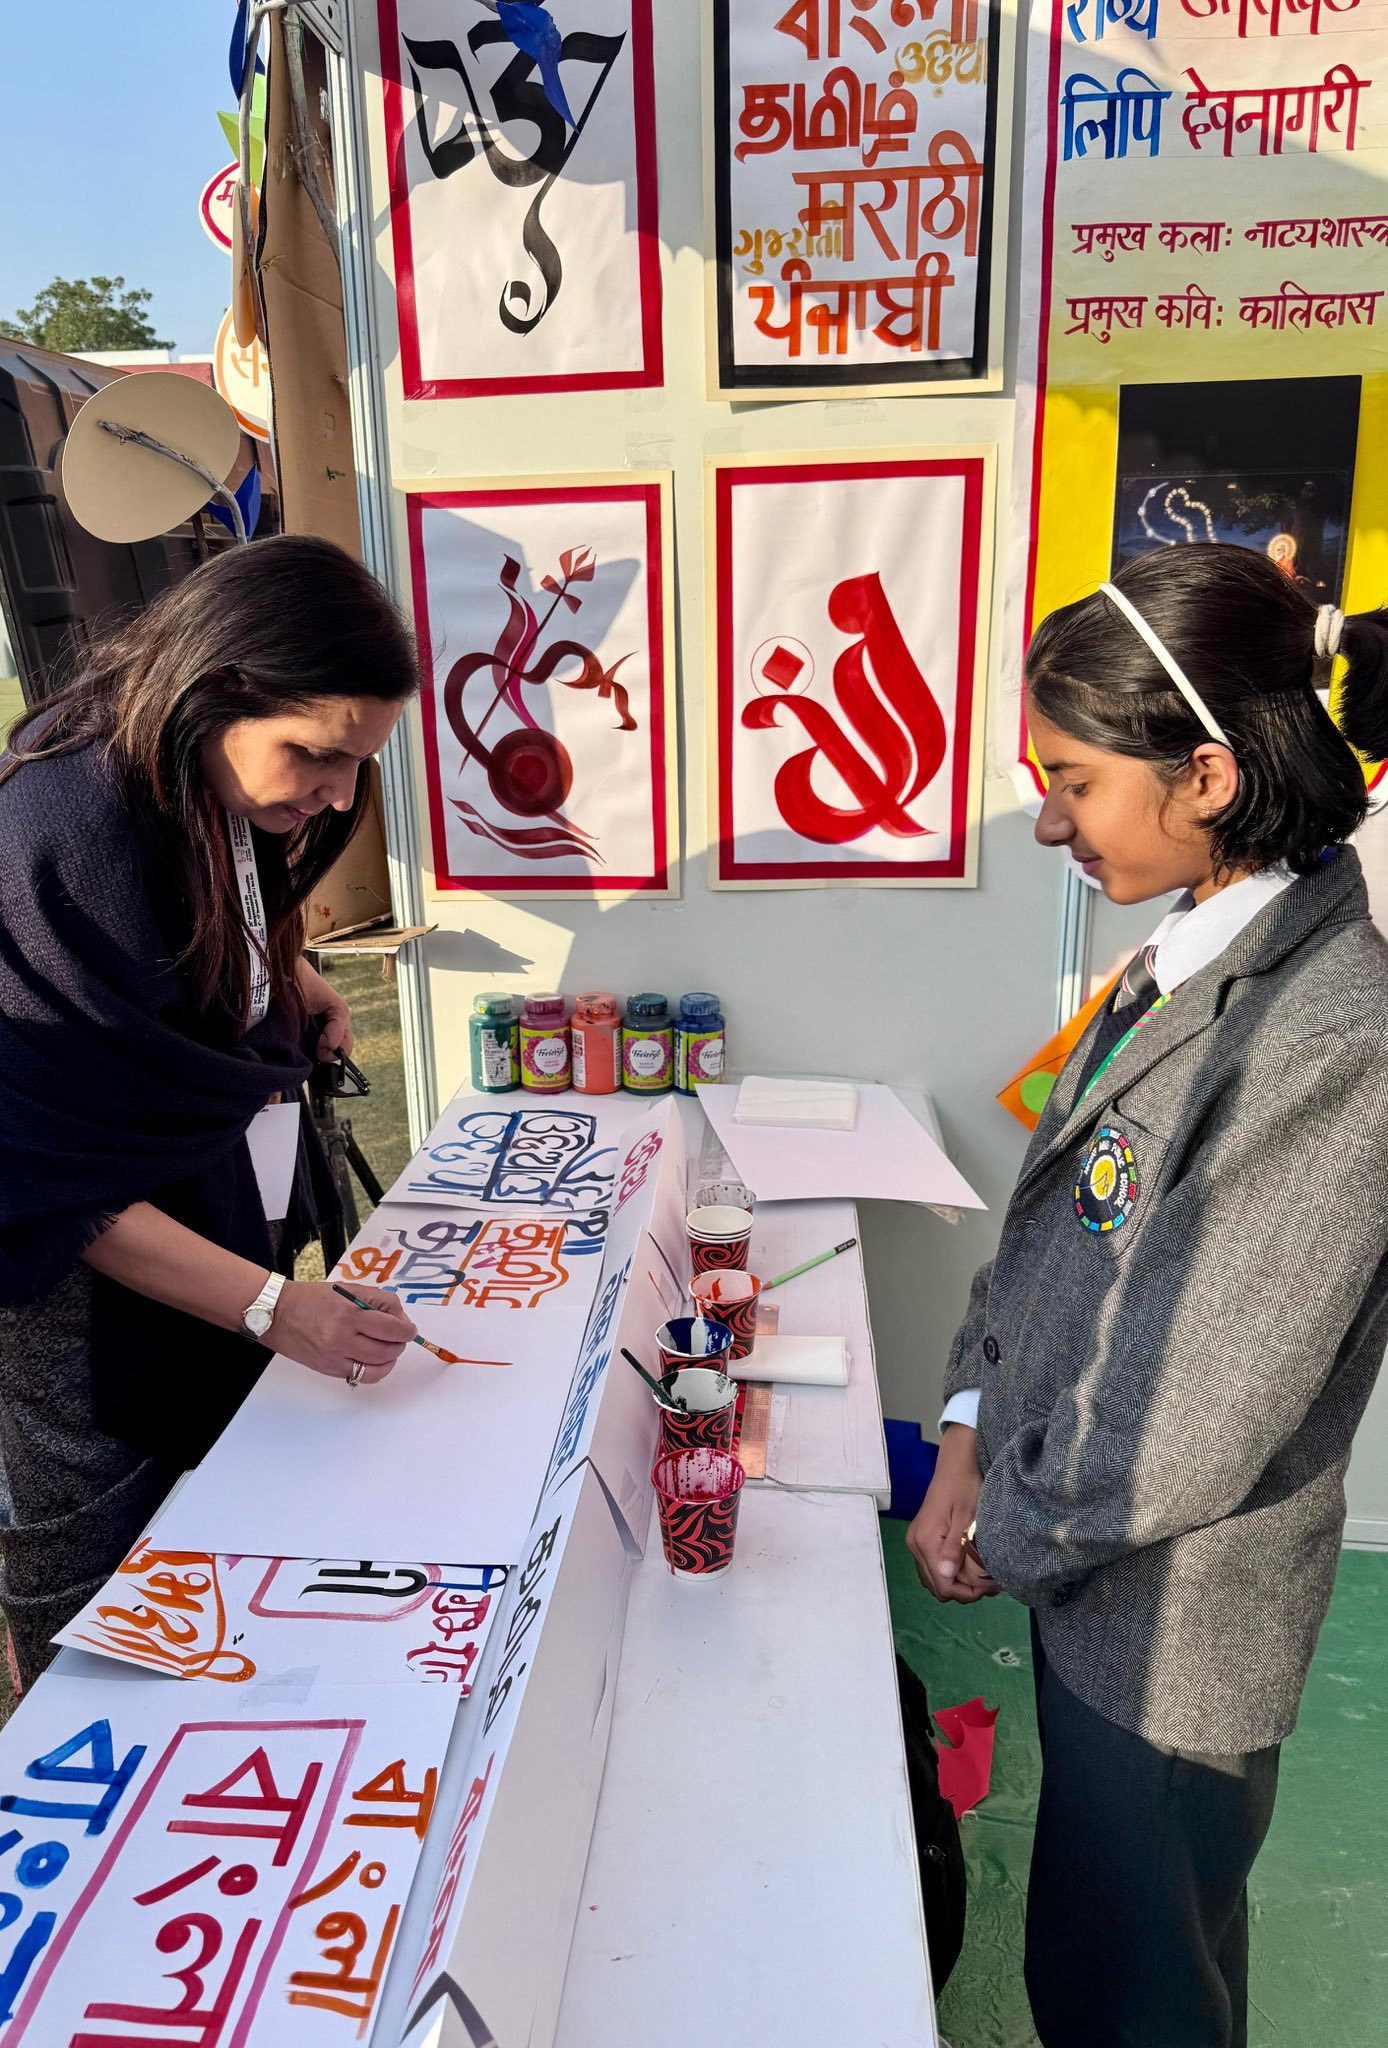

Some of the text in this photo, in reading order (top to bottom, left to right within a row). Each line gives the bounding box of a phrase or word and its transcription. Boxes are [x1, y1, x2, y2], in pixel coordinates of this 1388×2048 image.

[734, 66, 918, 168] தமிழ்
[1060, 63, 1373, 162] लिपि देवनागरी
[791, 129, 985, 262] मराठी
[1071, 222, 1153, 263] प्रमुख
[1064, 295, 1149, 344] प्रमुख
[1239, 280, 1385, 335] कालिदास
[1113, 1172, 1129, 1208] SCHOOL
[70, 1746, 324, 2048] বাংলা
[288, 1759, 438, 2041] বাংলা
